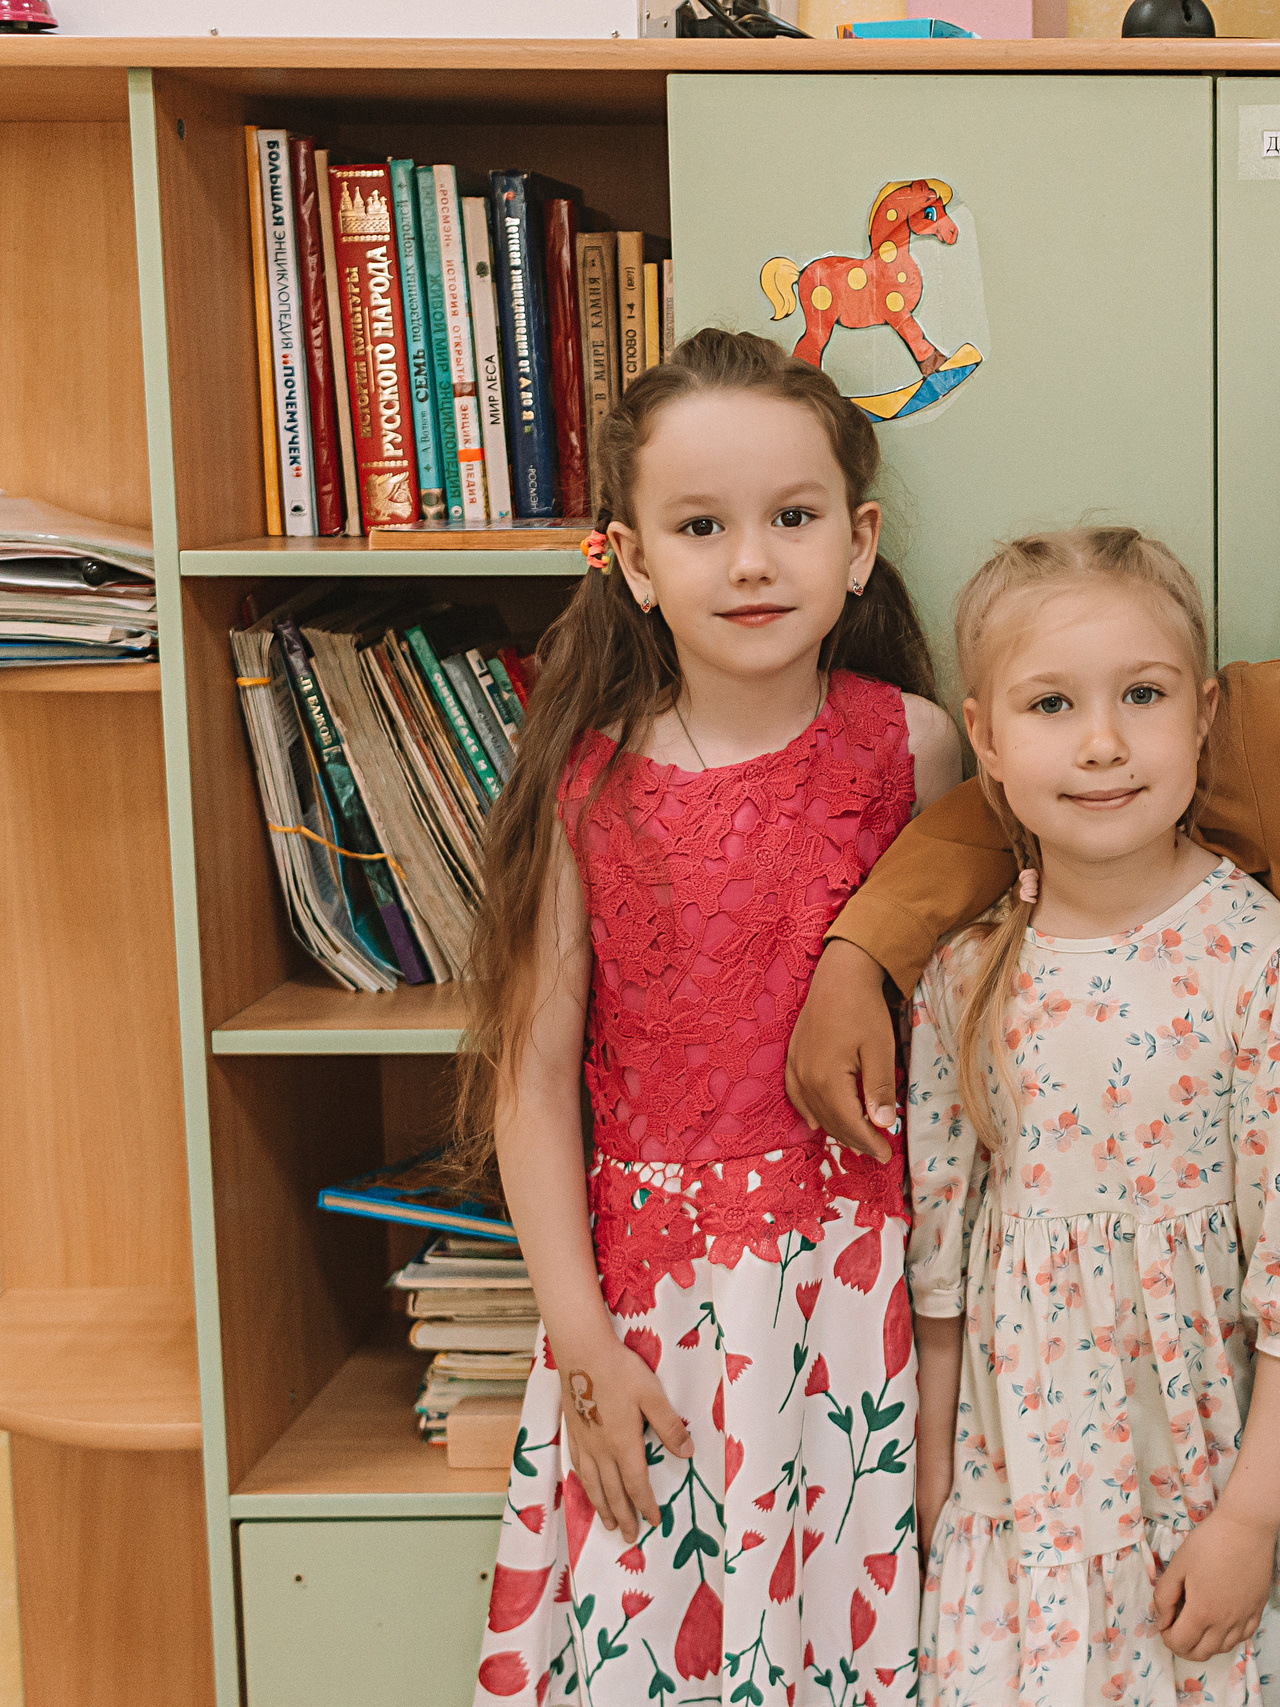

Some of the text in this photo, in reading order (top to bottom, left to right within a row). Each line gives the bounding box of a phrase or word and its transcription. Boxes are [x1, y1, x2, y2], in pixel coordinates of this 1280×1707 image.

[267, 139, 285, 227] БОЛЬШАЯ
[505, 216, 523, 266] Детская
[271, 229, 294, 349] ЭНЦИКЛОПЕДИЯ
[404, 265, 422, 343] подземных
[445, 258, 461, 318] ИСТОРИЯ
[508, 269, 530, 357] энциклопедия
[588, 276, 603, 328] КАМНЯ
[366, 245, 404, 458] РУССКОГО НАРОДА
[412, 348, 430, 404] СЕМЬ
[432, 338, 449, 373] МИР
[452, 324, 467, 383] ОТКРЫТИ
[591, 339, 606, 381] МИРЕ
[485, 354, 502, 425] МИР ЛЕСА
[439, 380, 461, 499] ЭНЦИКЛОПЕДИЯ
[460, 404, 477, 505] ЭНЦИКПЕДИЯ
[306, 694, 333, 746] БАЖОВ
